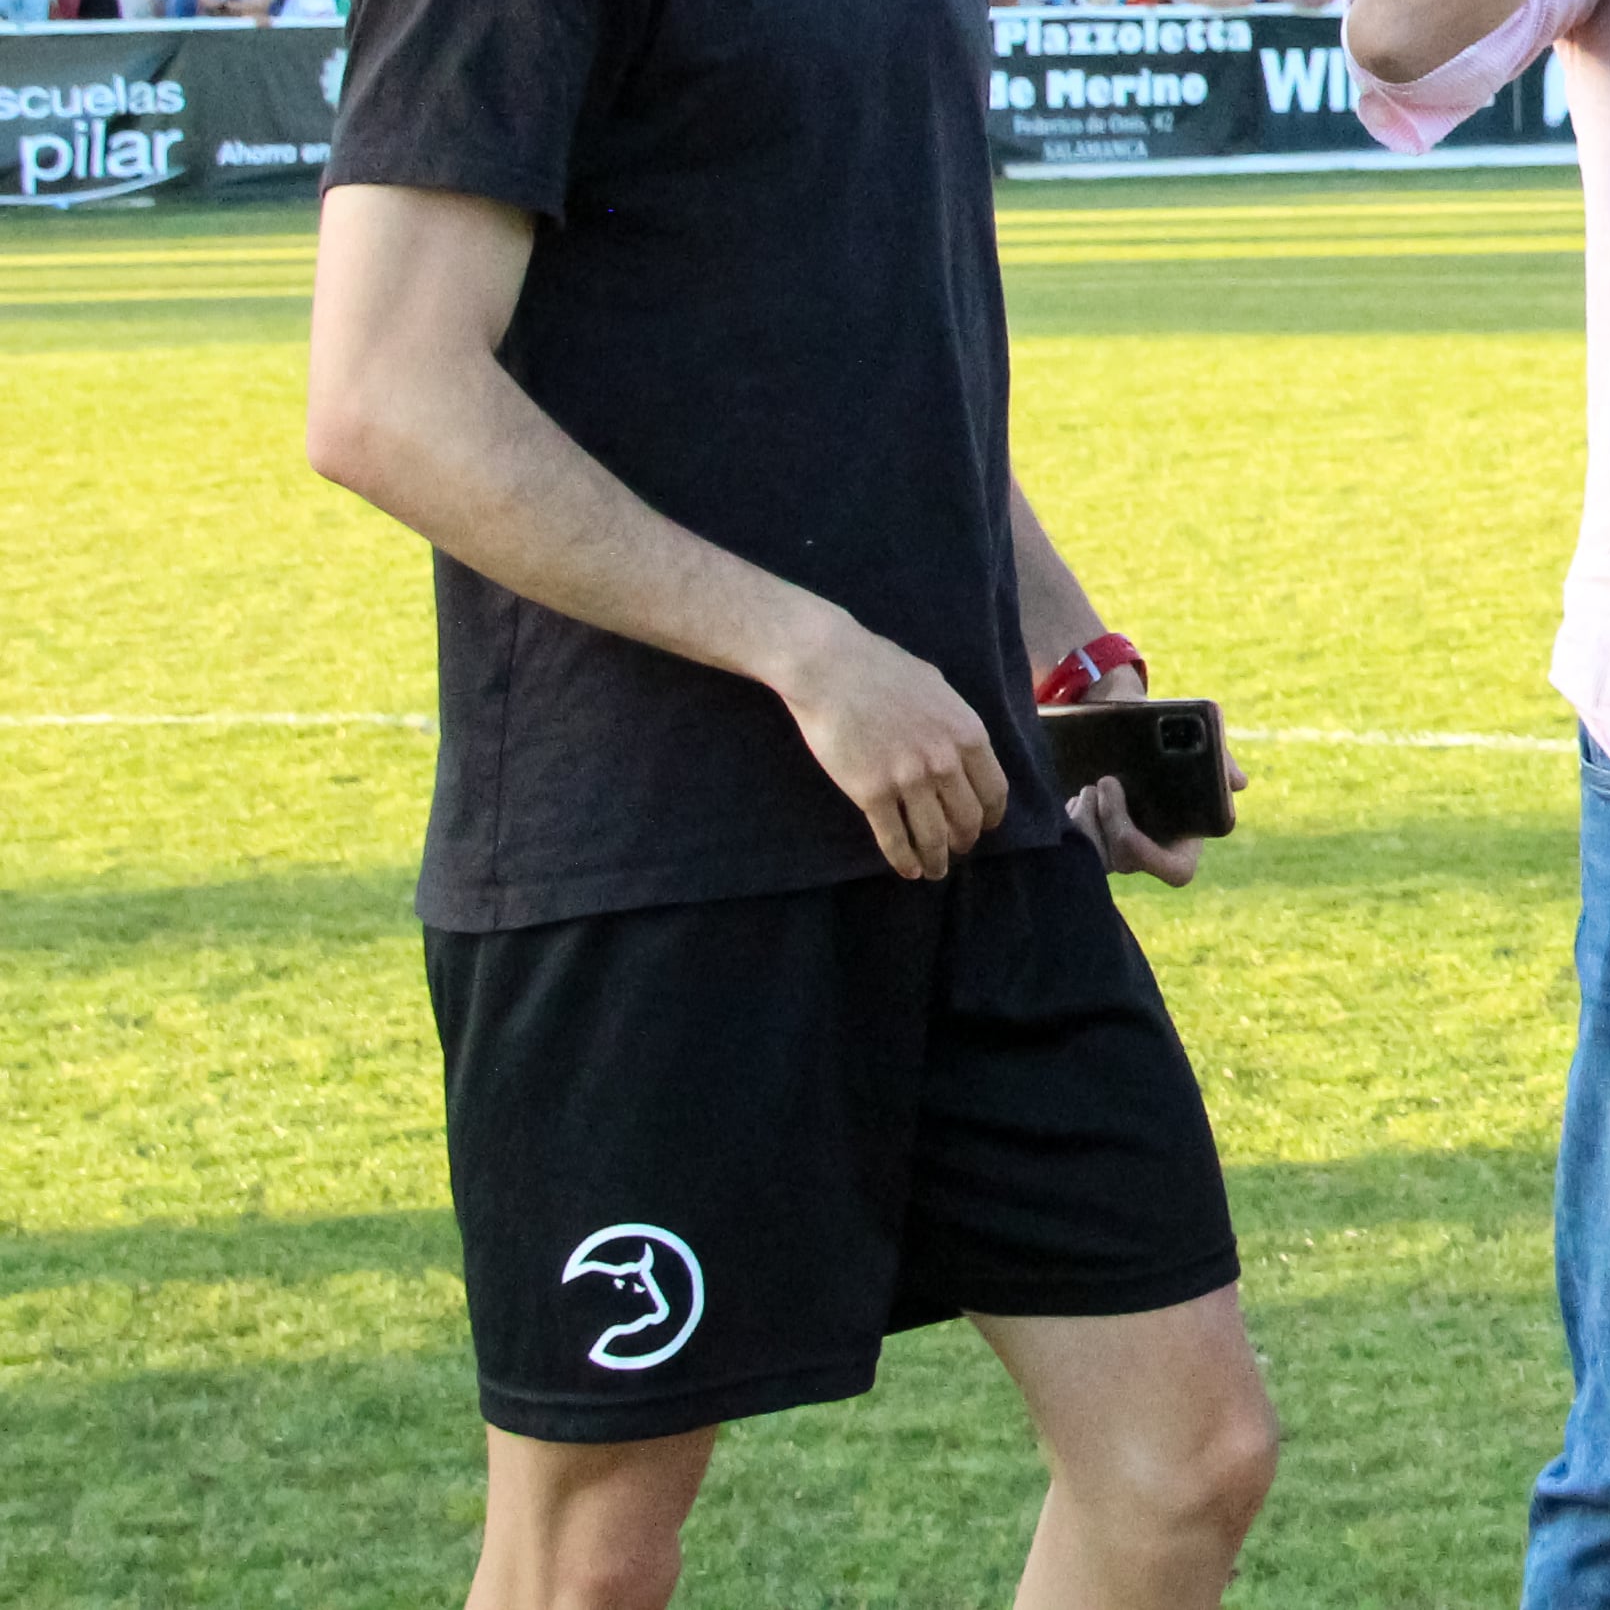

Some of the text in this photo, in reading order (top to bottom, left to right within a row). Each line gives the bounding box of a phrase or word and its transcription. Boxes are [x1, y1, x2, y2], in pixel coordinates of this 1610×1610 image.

[994, 18, 1252, 57] Plazzoletta
[1045, 68, 1209, 109] Merino
[20, 118, 185, 197] pilar
[216, 138, 298, 167] Ahorro
